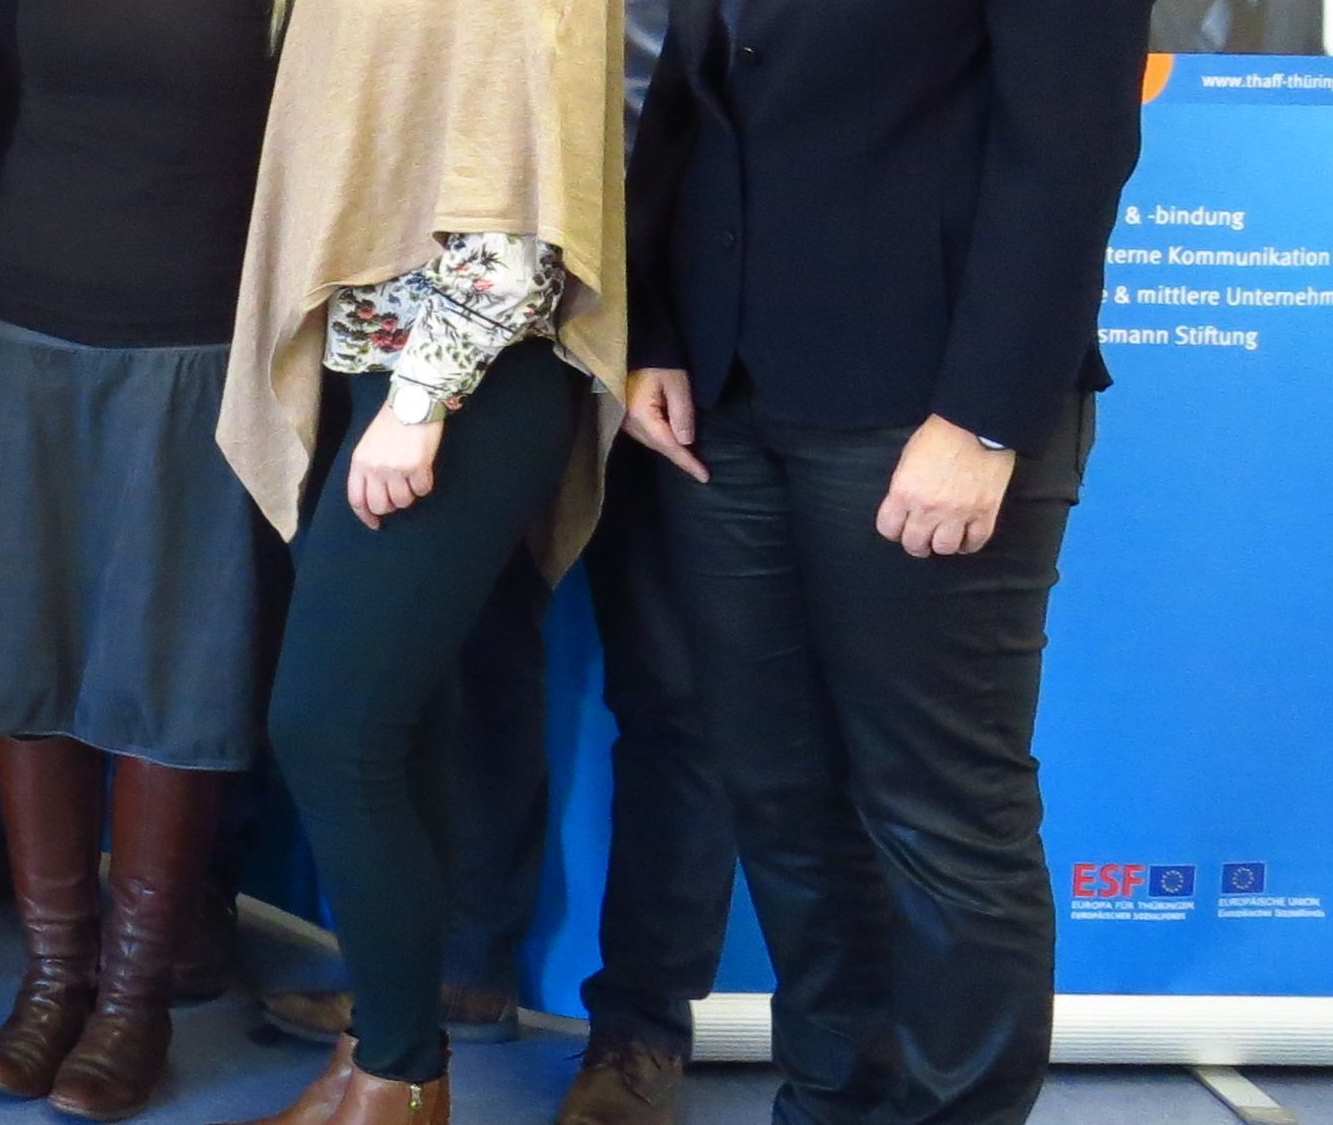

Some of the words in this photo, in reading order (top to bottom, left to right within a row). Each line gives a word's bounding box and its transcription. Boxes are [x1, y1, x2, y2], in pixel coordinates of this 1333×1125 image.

[1201, 73, 1333, 91] www.thaff-thürin
[1125, 206, 1141, 225] &
[1147, 205, 1245, 230] -bindung
[1106, 247, 1162, 265] terne
[1168, 246, 1330, 266] Kommunikation
[1114, 286, 1130, 304] &
[1137, 285, 1220, 306] mittlere
[1226, 286, 1333, 306] Unternehm
[1097, 328, 1169, 344] smann
[1175, 325, 1258, 350] Stiftung
[1072, 863, 1145, 898] ESF
